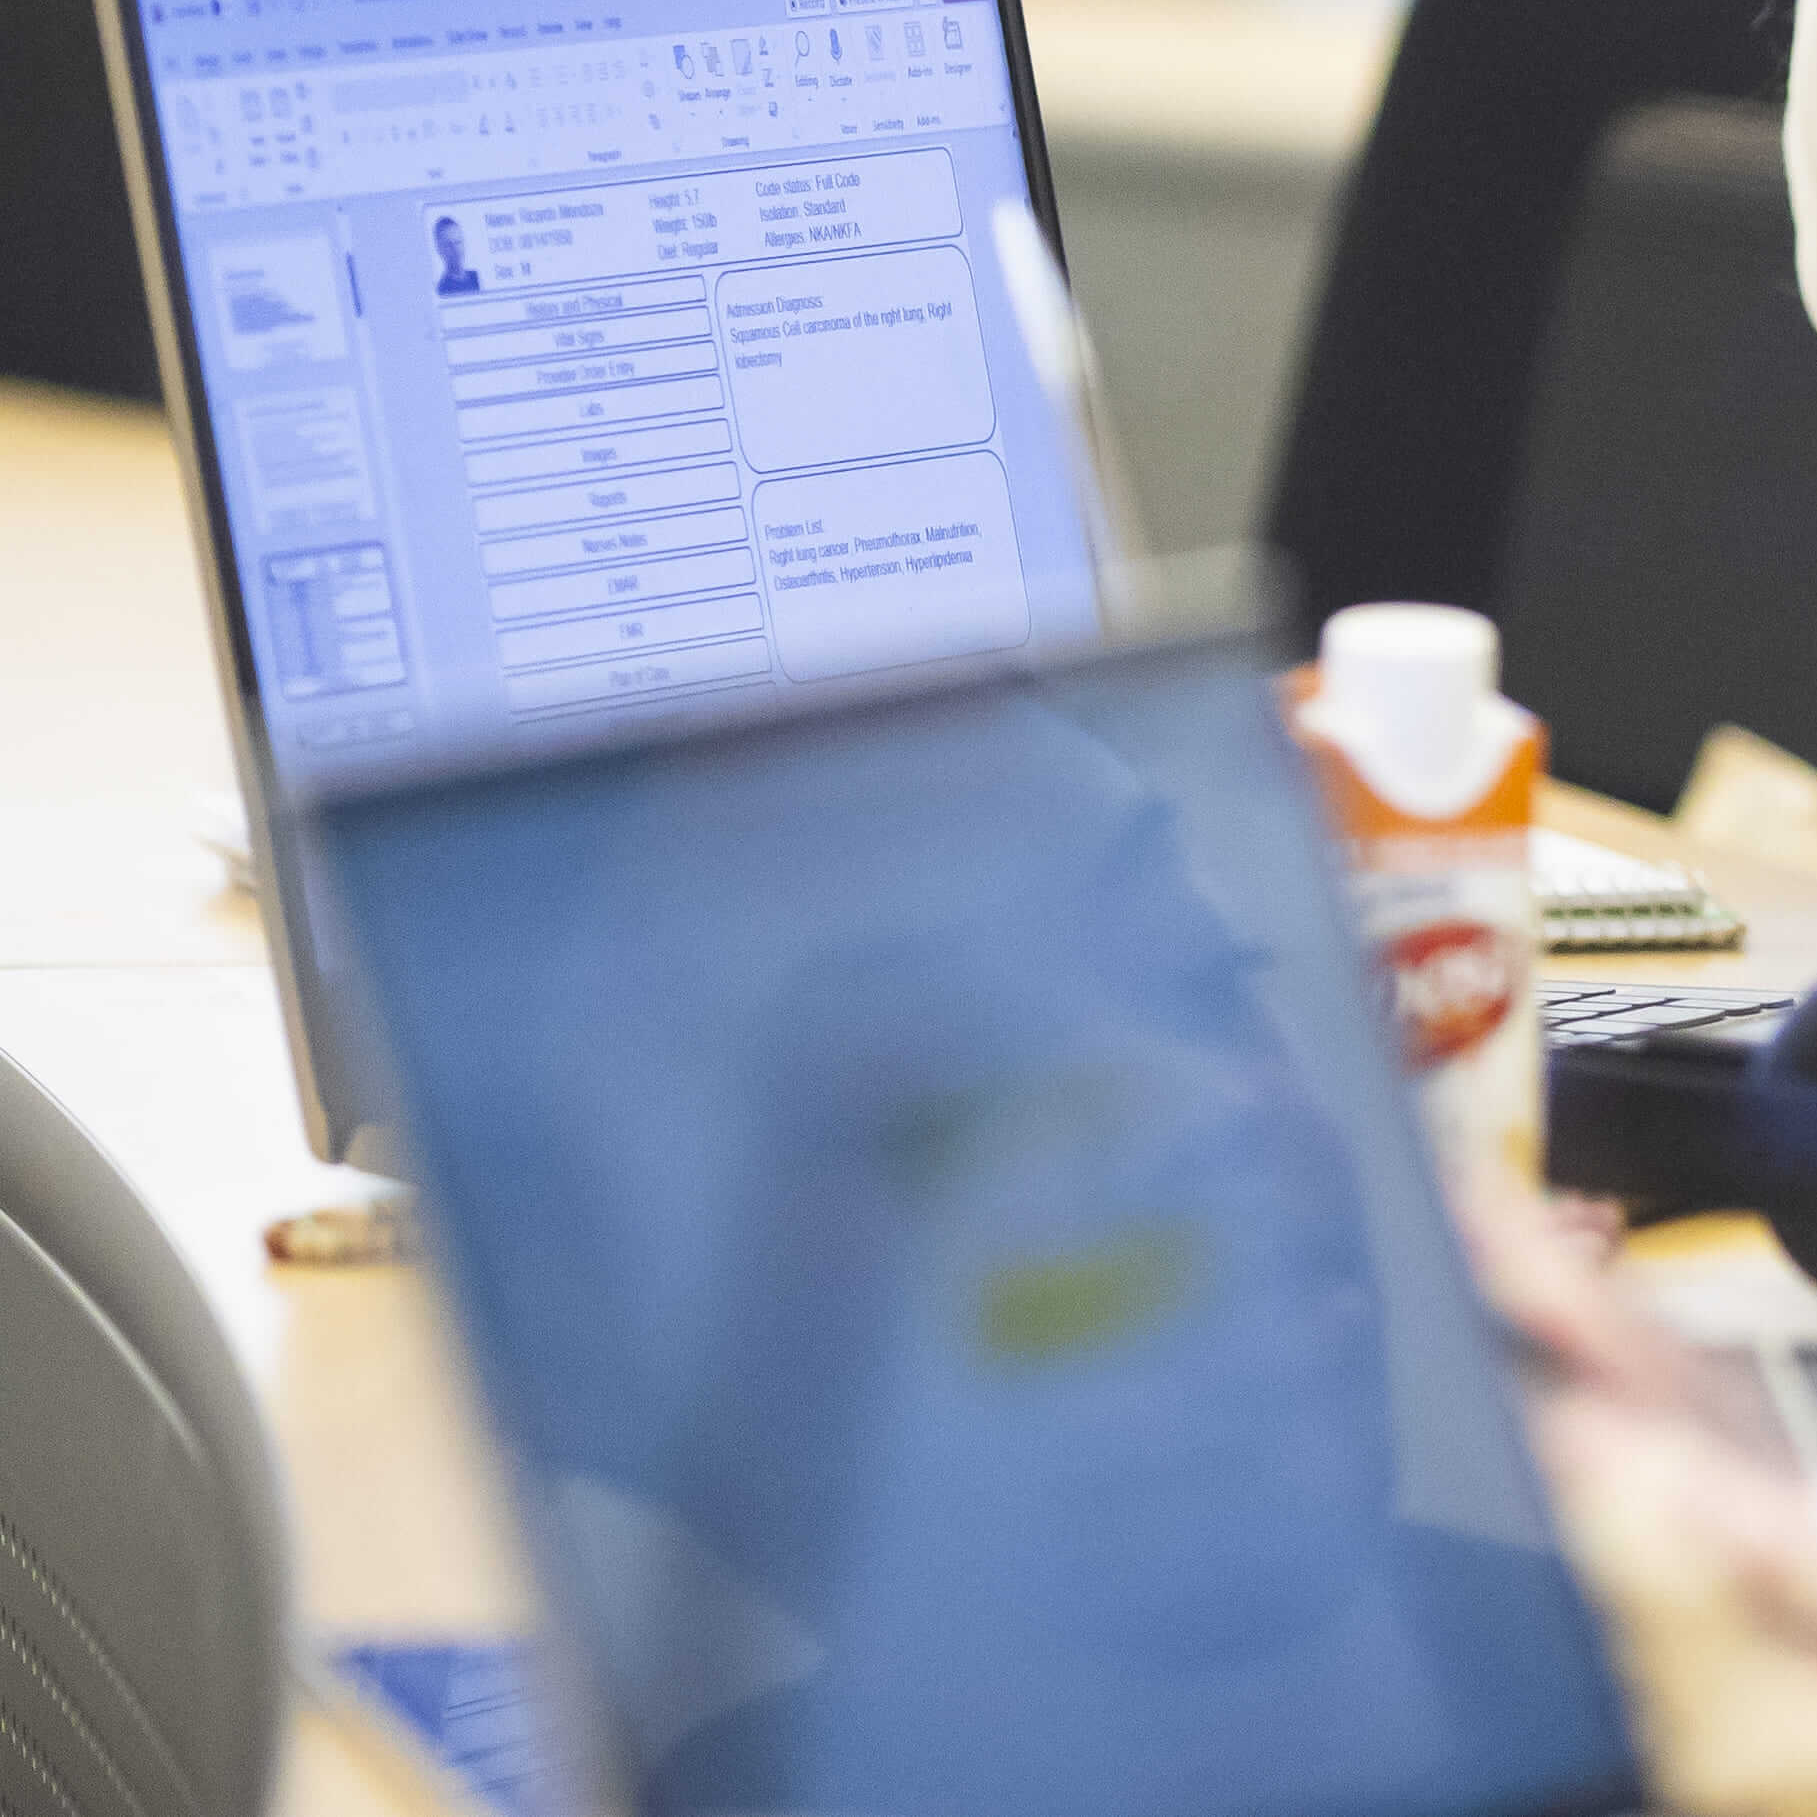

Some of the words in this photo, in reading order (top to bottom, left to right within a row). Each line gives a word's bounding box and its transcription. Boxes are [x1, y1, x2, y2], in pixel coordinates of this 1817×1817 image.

[755, 180, 781, 198] Code
[815, 174, 834, 191] Full
[834, 171, 860, 189] Code
[803, 197, 846, 217] Standard
[681, 240, 718, 260] Regular
[562, 297, 581, 315] and
[726, 300, 775, 318] Admission
[730, 323, 781, 345] Squamous
[782, 320, 802, 339] Cell
[803, 316, 852, 335] carcinoma
[863, 310, 880, 328] the
[880, 307, 902, 328] right
[927, 301, 953, 321] Right
[608, 359, 635, 379] Entry
[734, 349, 783, 369] lobectomy
[764, 523, 805, 541] Problem
[769, 545, 796, 567] Right
[795, 544, 817, 564] lung
[905, 549, 974, 571] Hyperlipidemia
